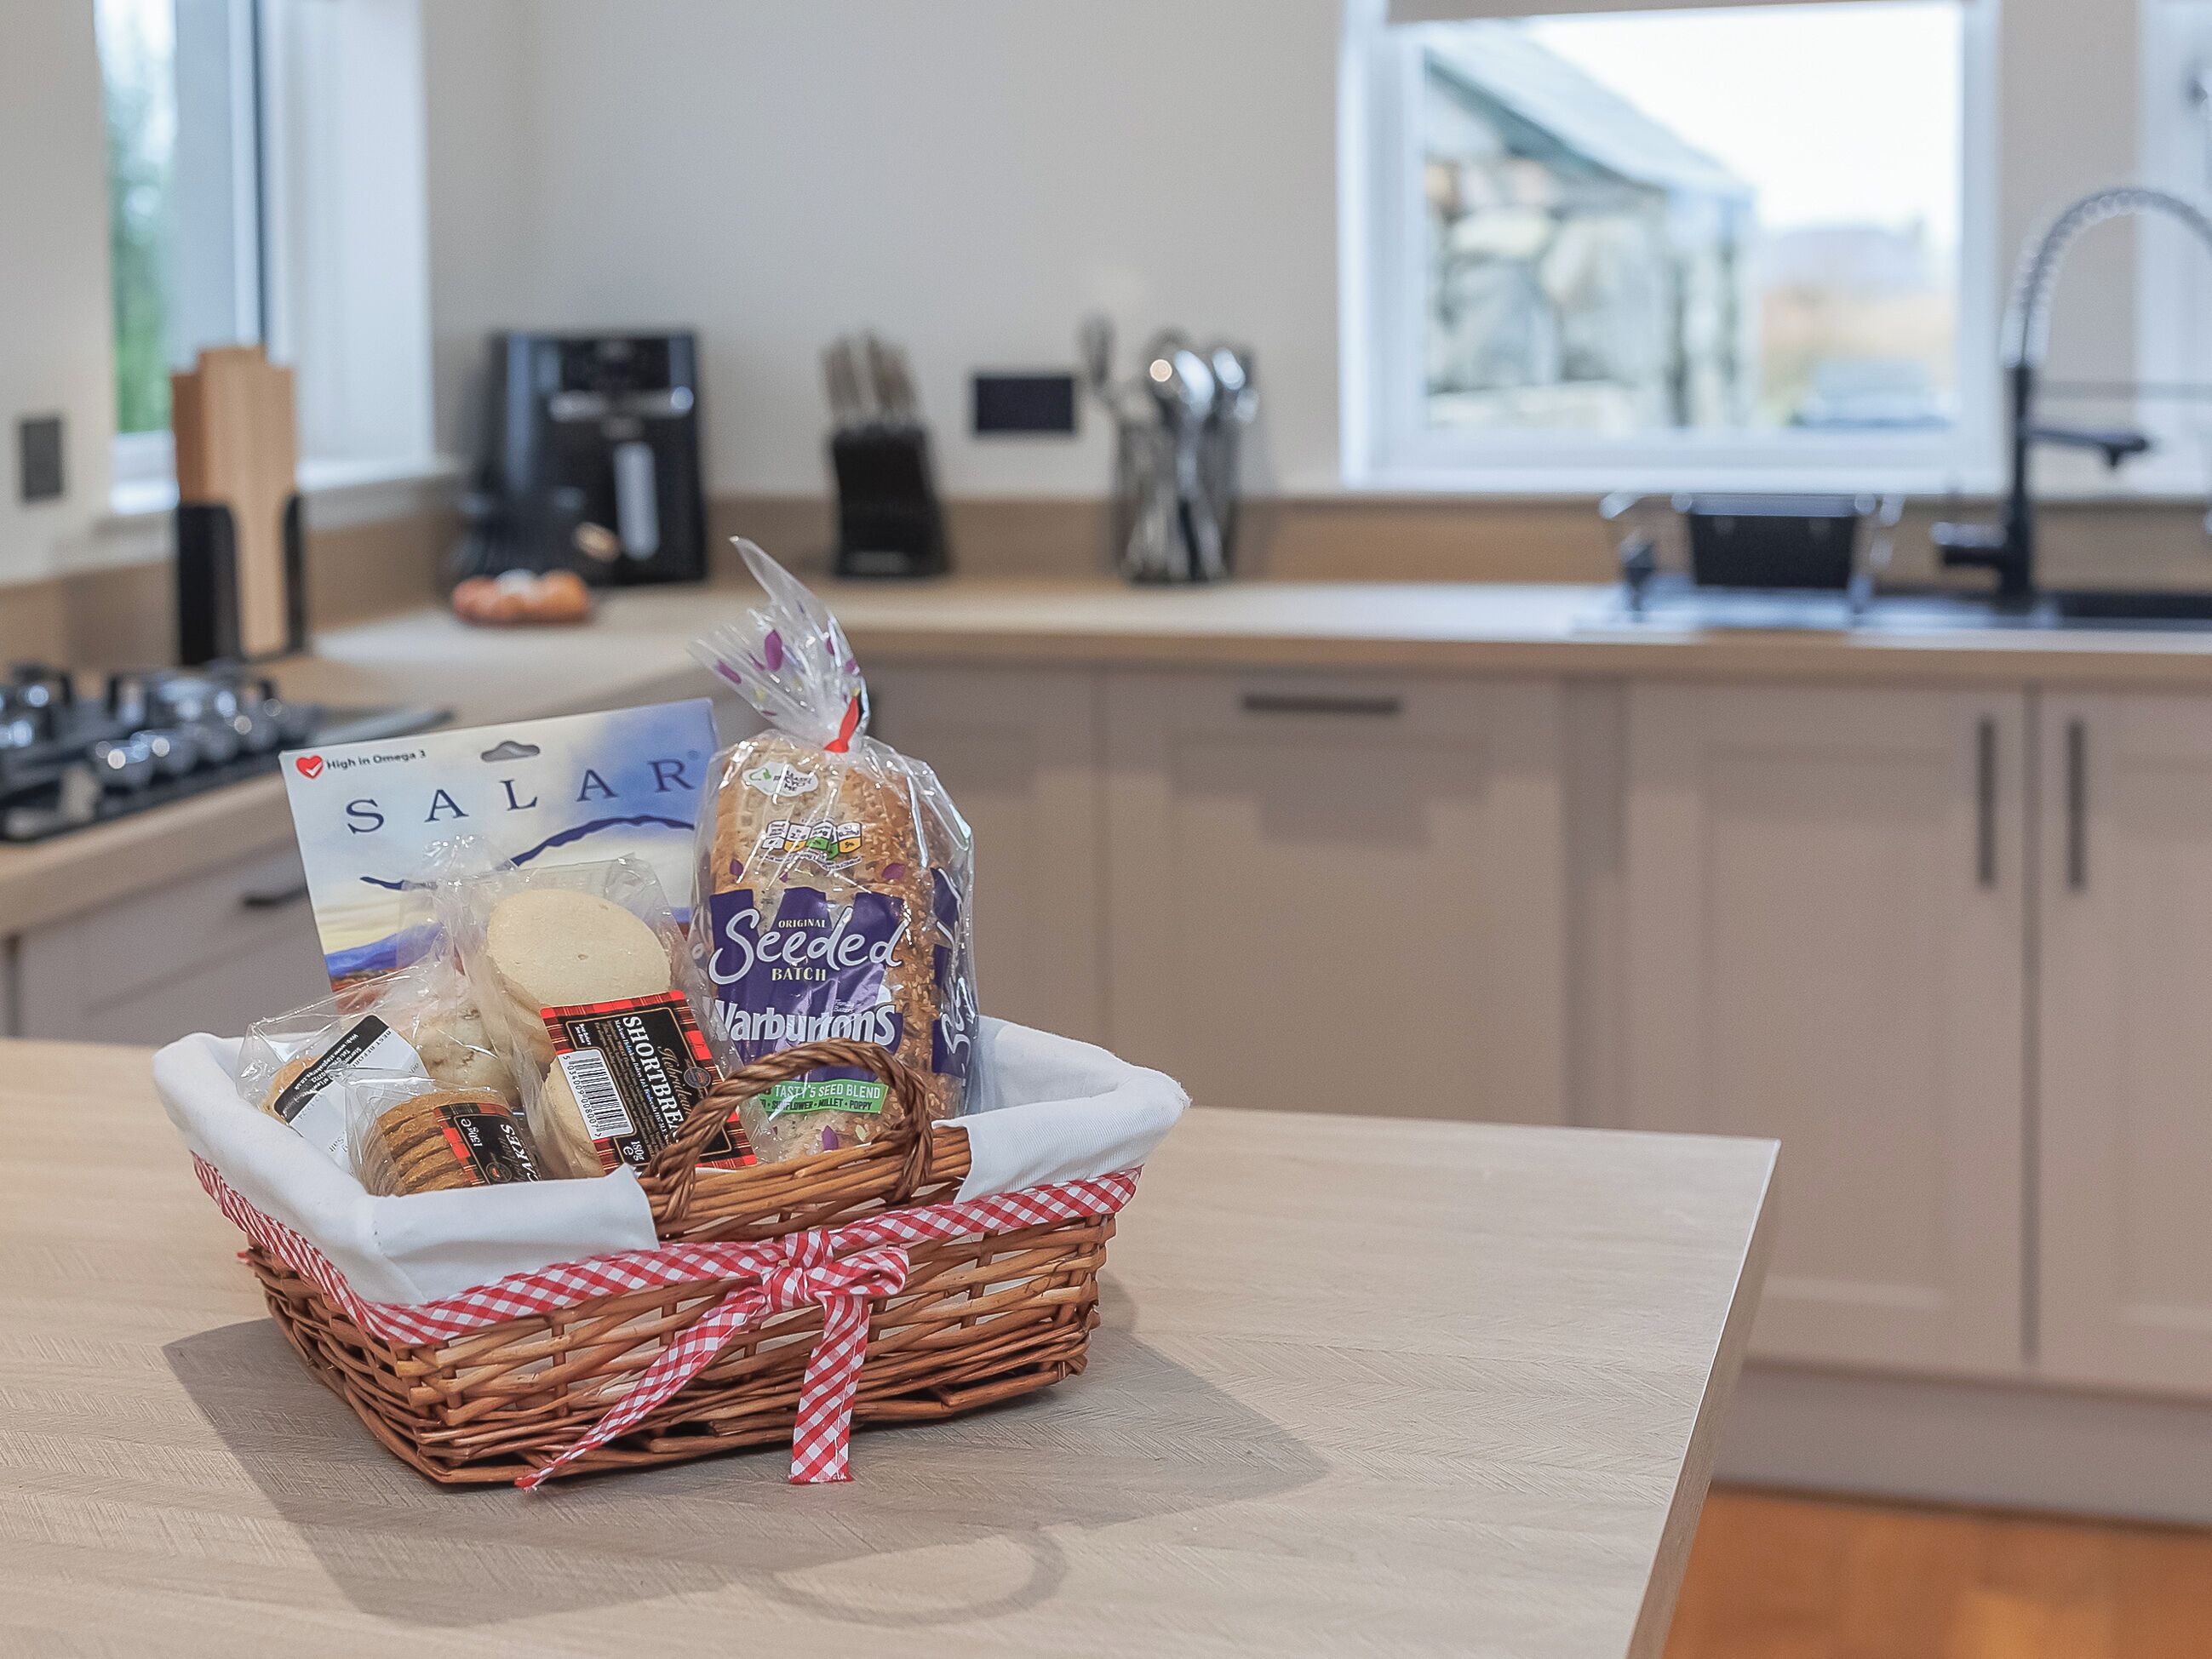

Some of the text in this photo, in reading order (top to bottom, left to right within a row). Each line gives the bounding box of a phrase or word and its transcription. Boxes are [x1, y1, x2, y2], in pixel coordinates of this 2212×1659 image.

[327, 749, 427, 770] High in Omega 3
[346, 758, 696, 834] SALAR
[778, 918, 827, 929] ORIGINAL
[708, 906, 909, 985] Seeded
[771, 968, 828, 981] BATCH
[701, 995, 897, 1046] Warburtons
[375, 1030, 392, 1045] BEST
[622, 1015, 684, 1143] SHORTBRE
[657, 1046, 692, 1115] Hebridean
[566, 1065, 586, 1095] 034009
[580, 1097, 599, 1128] 008007
[775, 1084, 806, 1099] TASTY
[818, 1084, 844, 1097] SEED
[846, 1084, 881, 1099] BLEND
[818, 1098, 844, 1107] MILLET
[850, 1100, 873, 1110] POPPY
[467, 1127, 483, 1147] 150g
[500, 1124, 540, 1182] CAKES
[630, 1141, 645, 1161] 180g
